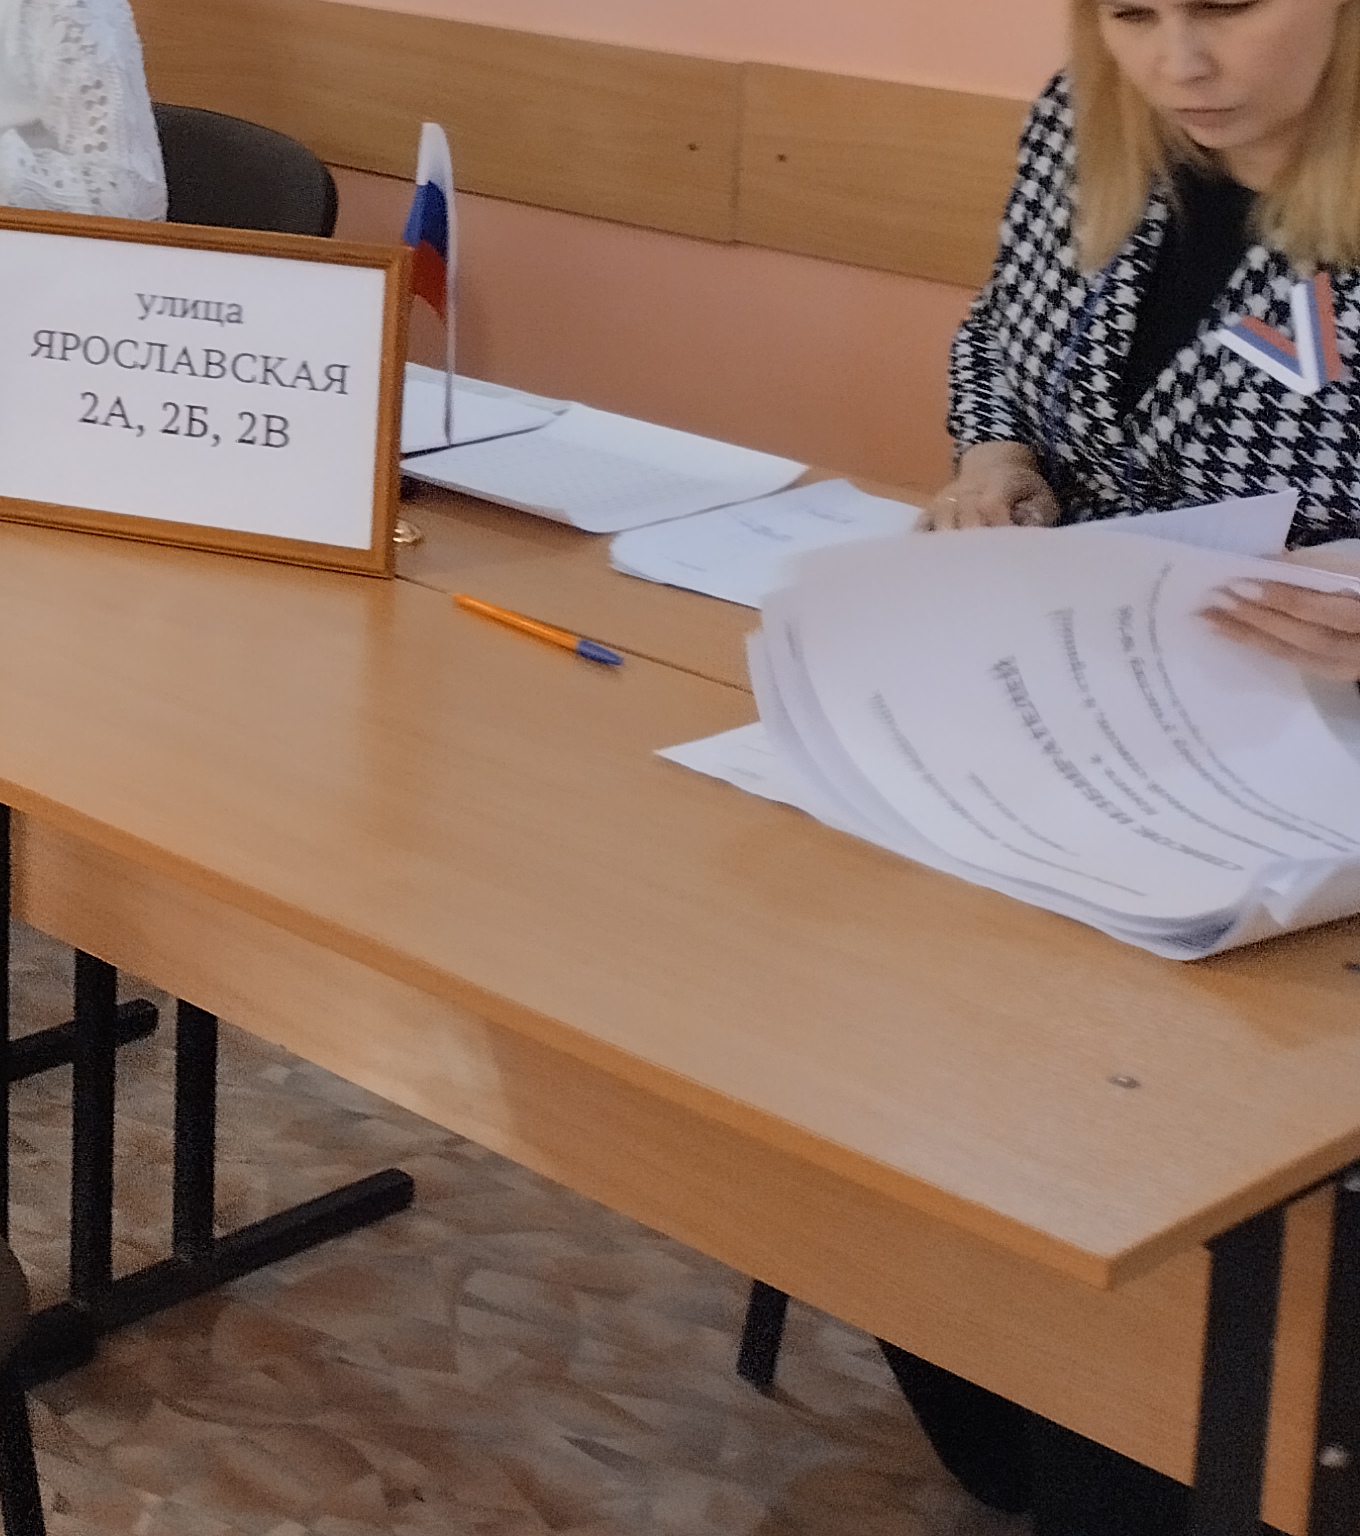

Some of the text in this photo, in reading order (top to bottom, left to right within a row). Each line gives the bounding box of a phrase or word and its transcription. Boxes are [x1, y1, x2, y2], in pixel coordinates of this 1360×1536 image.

[135, 291, 244, 327] улица
[30, 329, 350, 395] ЯРОСЛАВСКАЯ
[78, 390, 291, 449] 2А, 2Б, 2В
